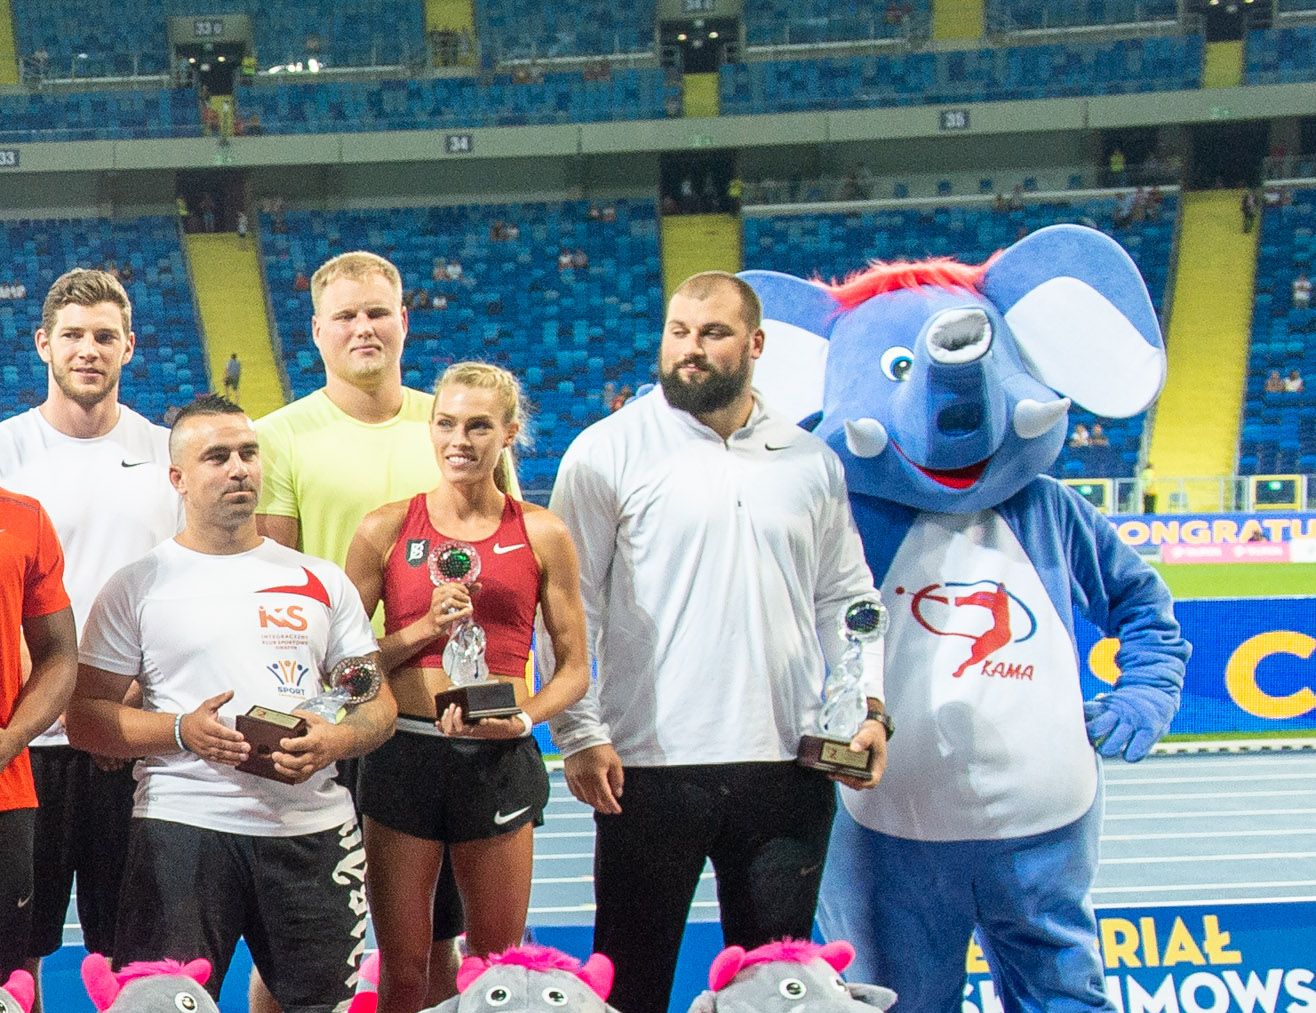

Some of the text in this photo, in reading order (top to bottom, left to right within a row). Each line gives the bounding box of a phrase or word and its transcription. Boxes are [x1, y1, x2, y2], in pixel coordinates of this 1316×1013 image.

[449, 136, 467, 150] 34
[1110, 519, 1316, 545] ONGRATU
[981, 660, 1034, 681] KAMA
[277, 686, 305, 696] SPORT
